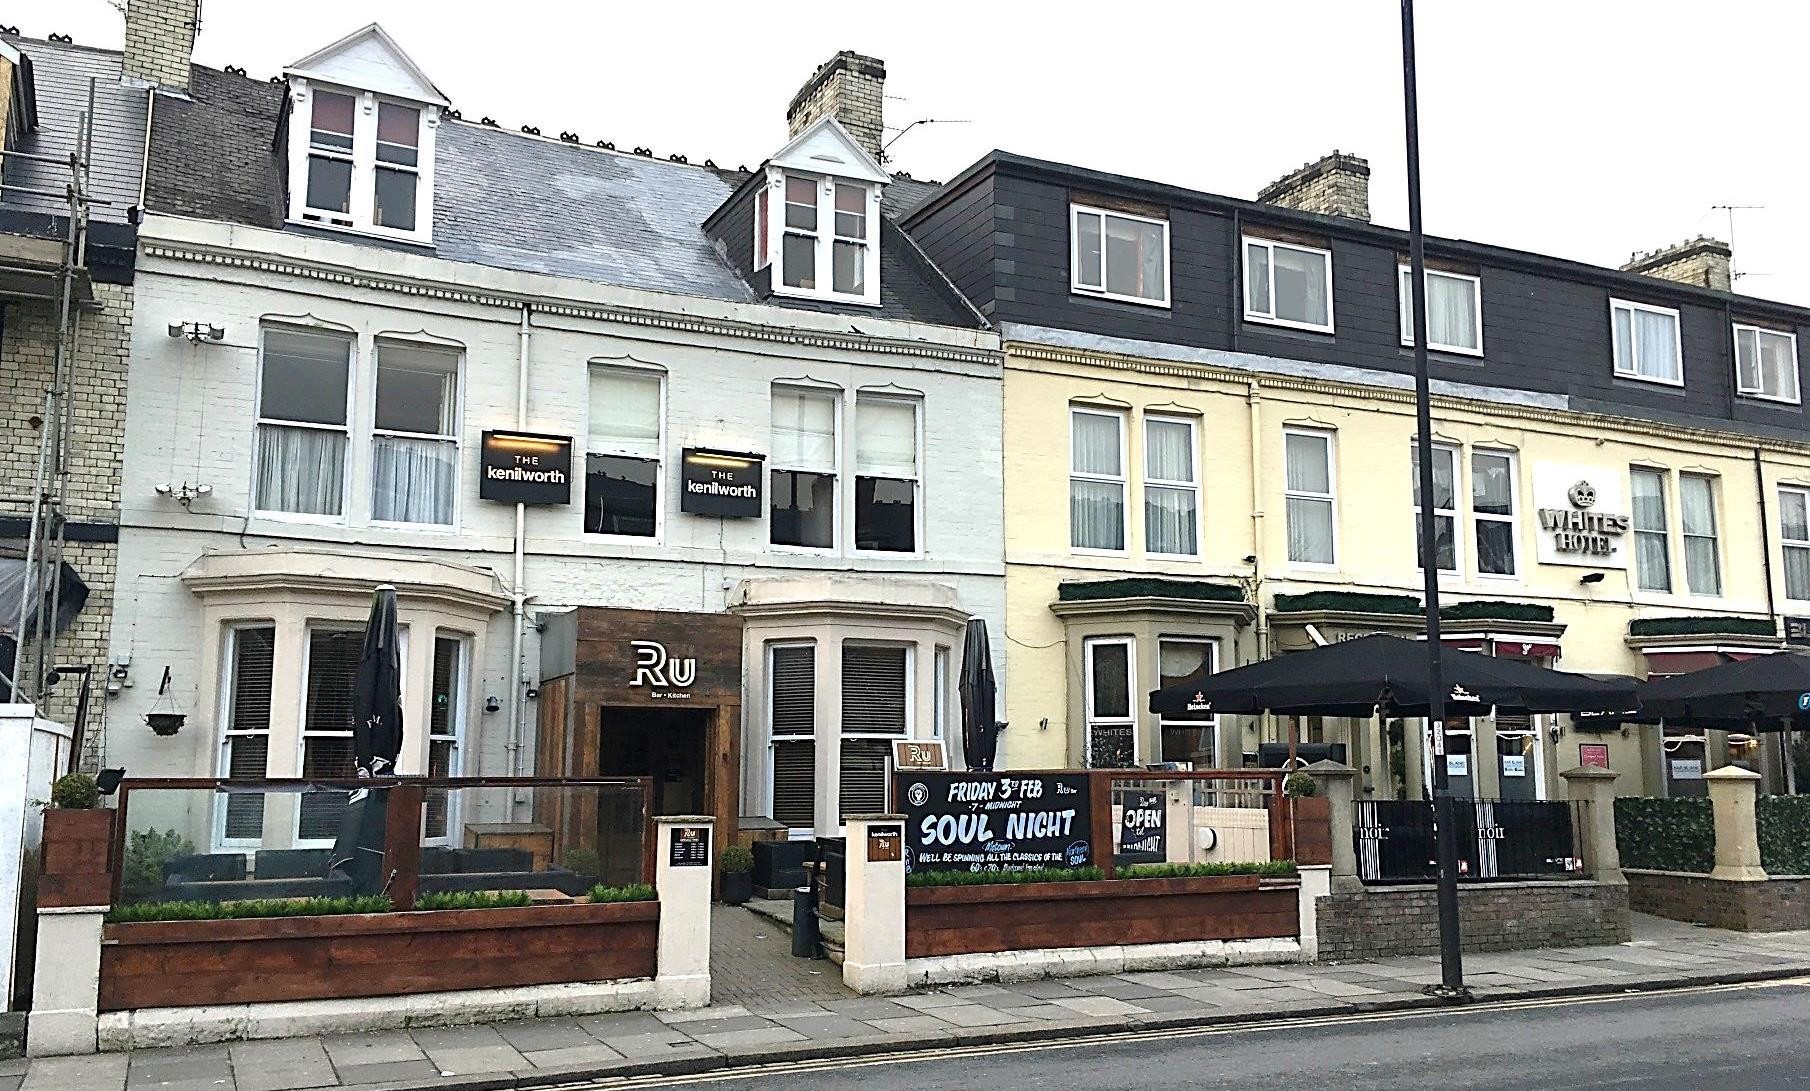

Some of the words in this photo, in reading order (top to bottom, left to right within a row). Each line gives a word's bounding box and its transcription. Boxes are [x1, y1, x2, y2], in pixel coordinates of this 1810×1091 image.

[514, 455, 539, 466] THE
[487, 466, 565, 483] kenilworth
[711, 470, 733, 481] THE
[687, 480, 757, 498] kenilworth
[1538, 508, 1629, 536] WHITES
[1554, 532, 1617, 555] HOTEL
[629, 640, 696, 687] Ru
[651, 691, 663, 699] Bar
[667, 692, 691, 700] Kitchen
[1093, 728, 1133, 737] WHITES
[908, 745, 932, 762] Ru
[947, 781, 997, 802] FRIDAY
[1019, 779, 1042, 799] FEB
[984, 800, 1022, 810] MIDNIGHT
[1124, 808, 1162, 828] OPEN
[920, 813, 993, 846] SOUL
[1006, 809, 1075, 840] NIGHT
[1478, 823, 1505, 839] noir
[942, 852, 953, 863] BE
[953, 853, 985, 863] SPINNING
[986, 852, 1000, 862] ALL
[1000, 852, 1012, 862] THE
[1012, 852, 1042, 862] CLASSICS
[1043, 852, 1052, 861] OF
[1052, 852, 1063, 861] THE
[1070, 854, 1087, 866] SOUL
